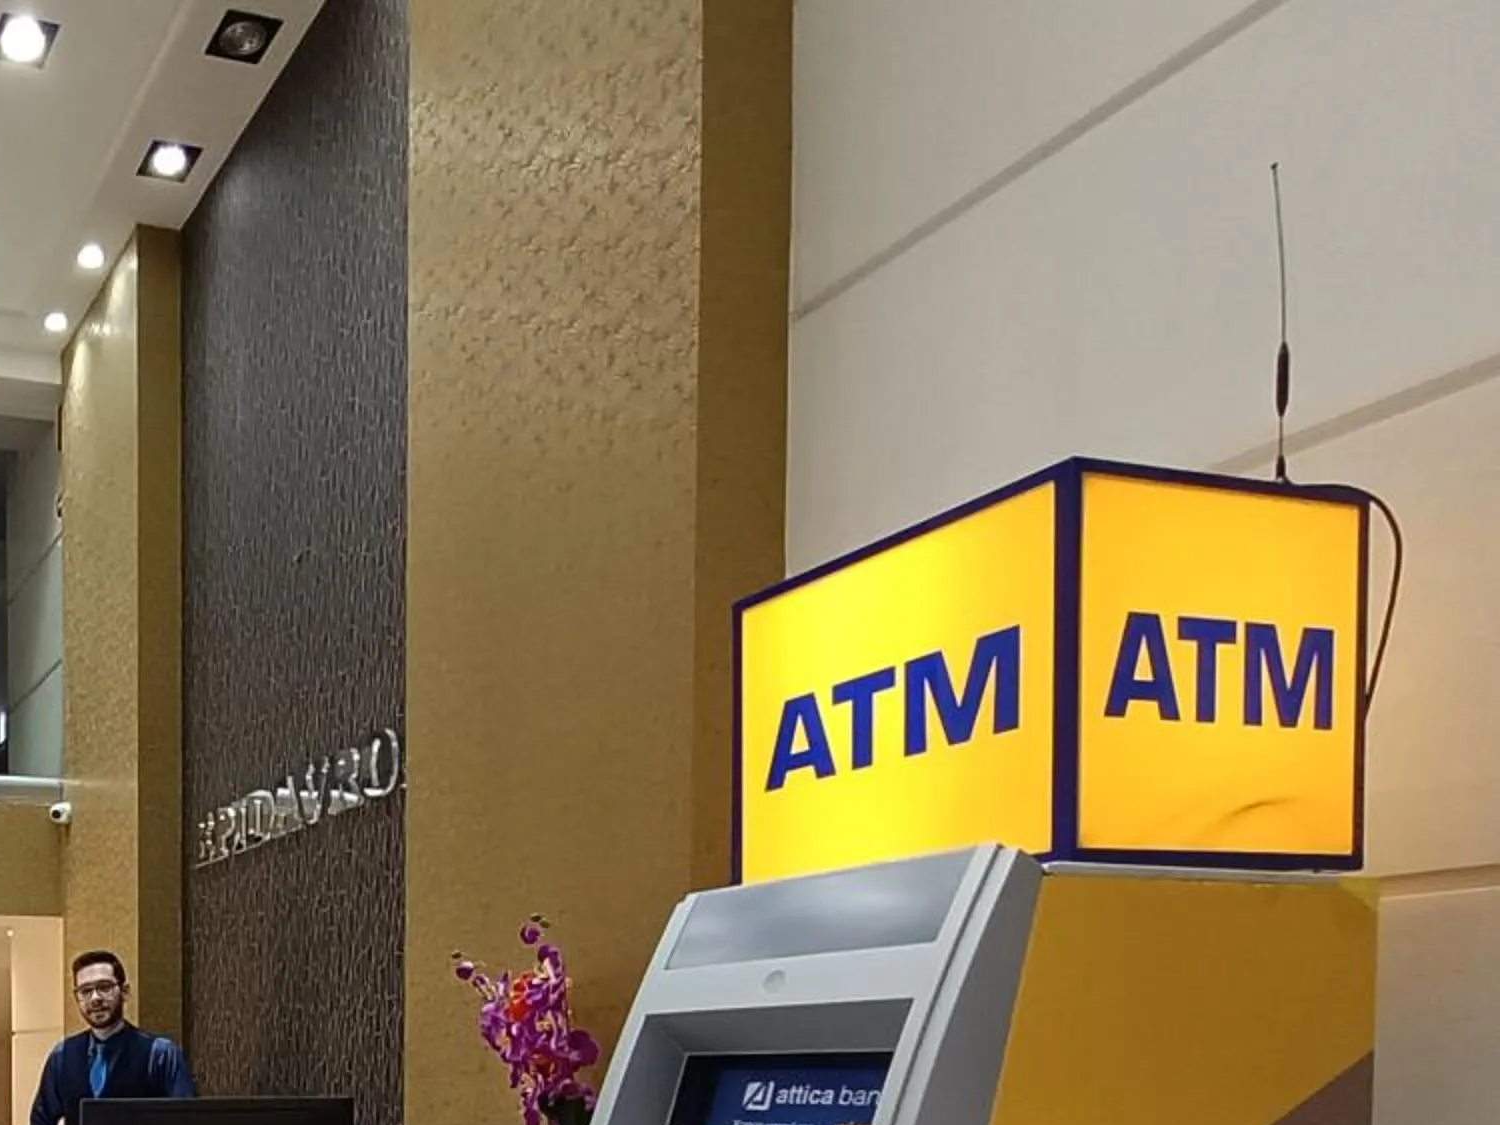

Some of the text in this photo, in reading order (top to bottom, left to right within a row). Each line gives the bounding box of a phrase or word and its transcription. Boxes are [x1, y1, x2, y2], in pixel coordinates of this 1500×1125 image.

[764, 624, 1021, 793] ATM
[1103, 611, 1334, 731] ATM
[775, 1084, 834, 1106] attica
